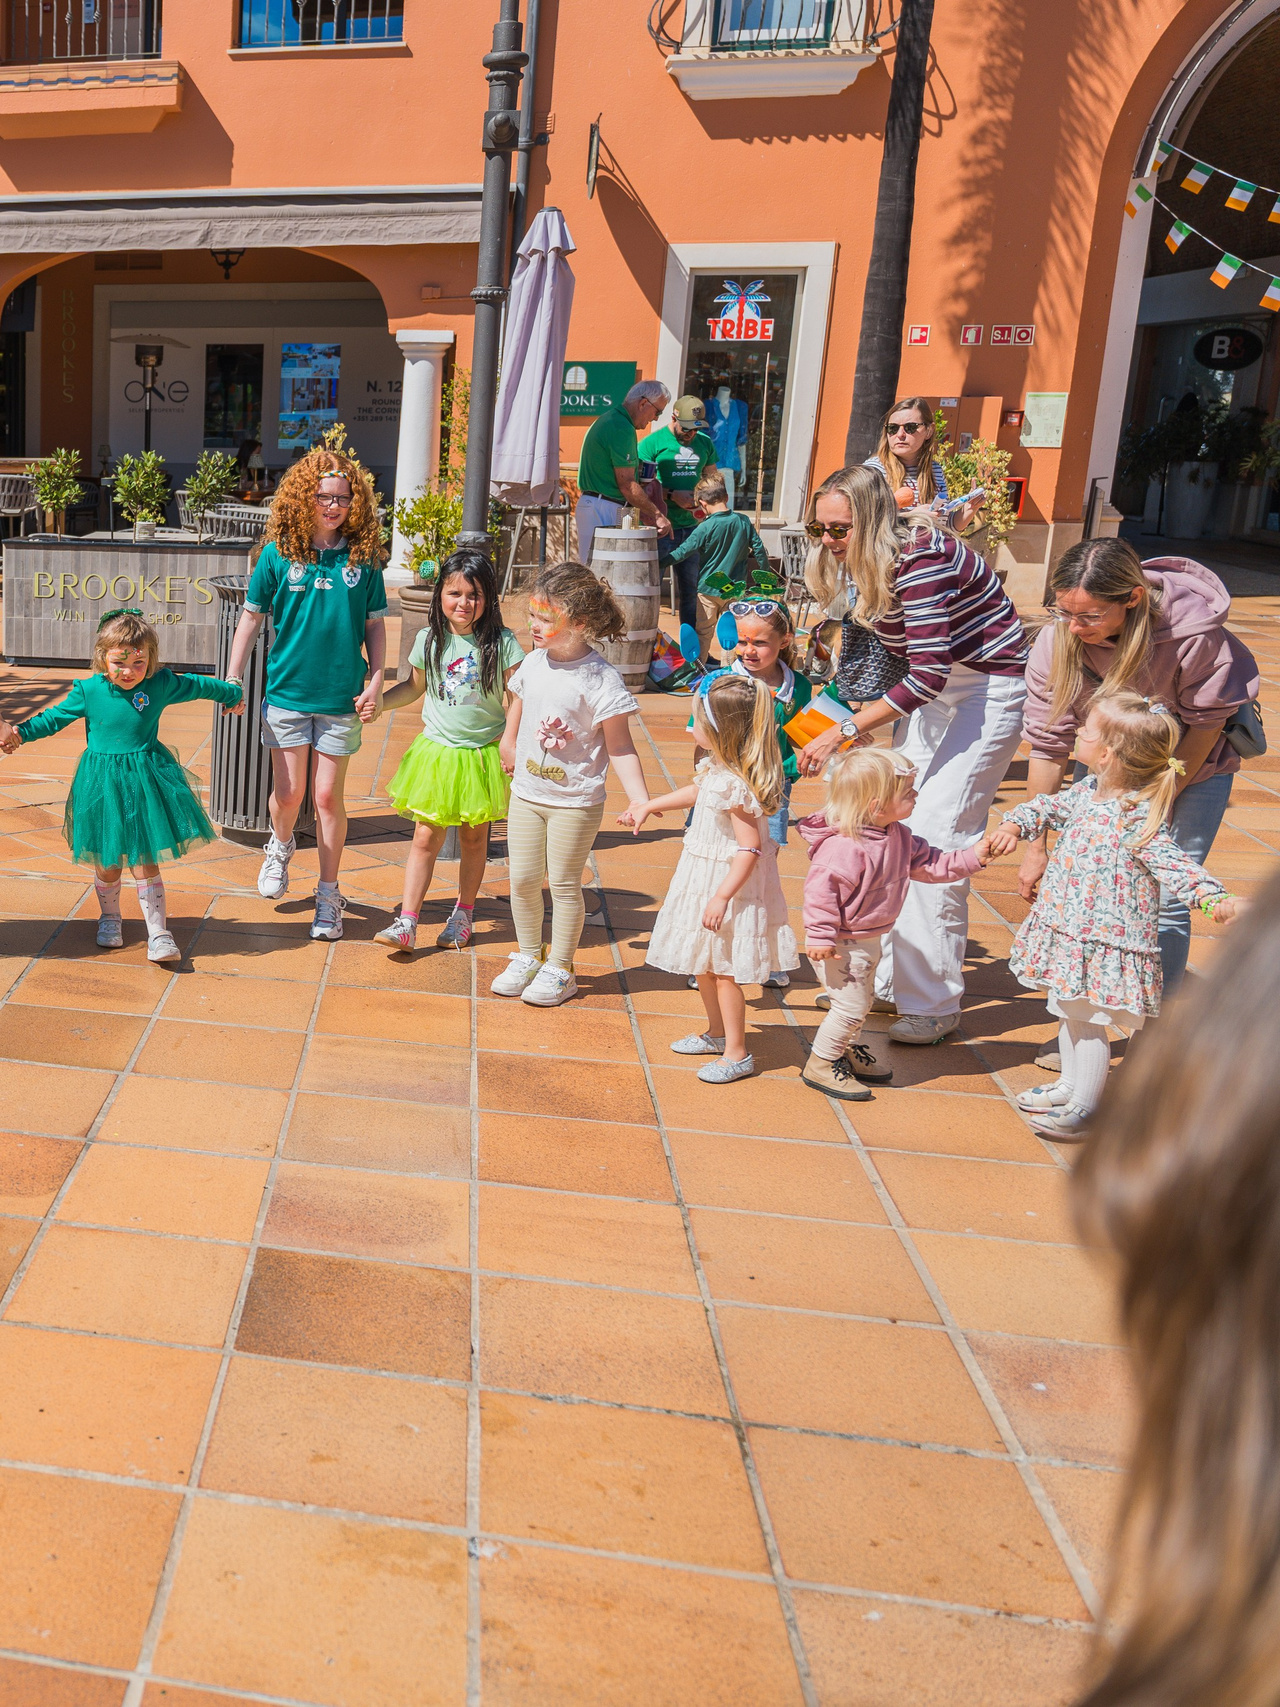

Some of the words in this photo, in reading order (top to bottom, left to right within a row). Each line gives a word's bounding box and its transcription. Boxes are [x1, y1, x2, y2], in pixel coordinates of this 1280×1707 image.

[707, 318, 774, 340] TRIBE
[993, 329, 1011, 341] S.I.
[366, 380, 382, 393] N.
[371, 398, 402, 406] ROUND
[559, 394, 612, 407] OOKE'S
[33, 571, 214, 605] BROOKE'S
[148, 612, 183, 625] SHOP
